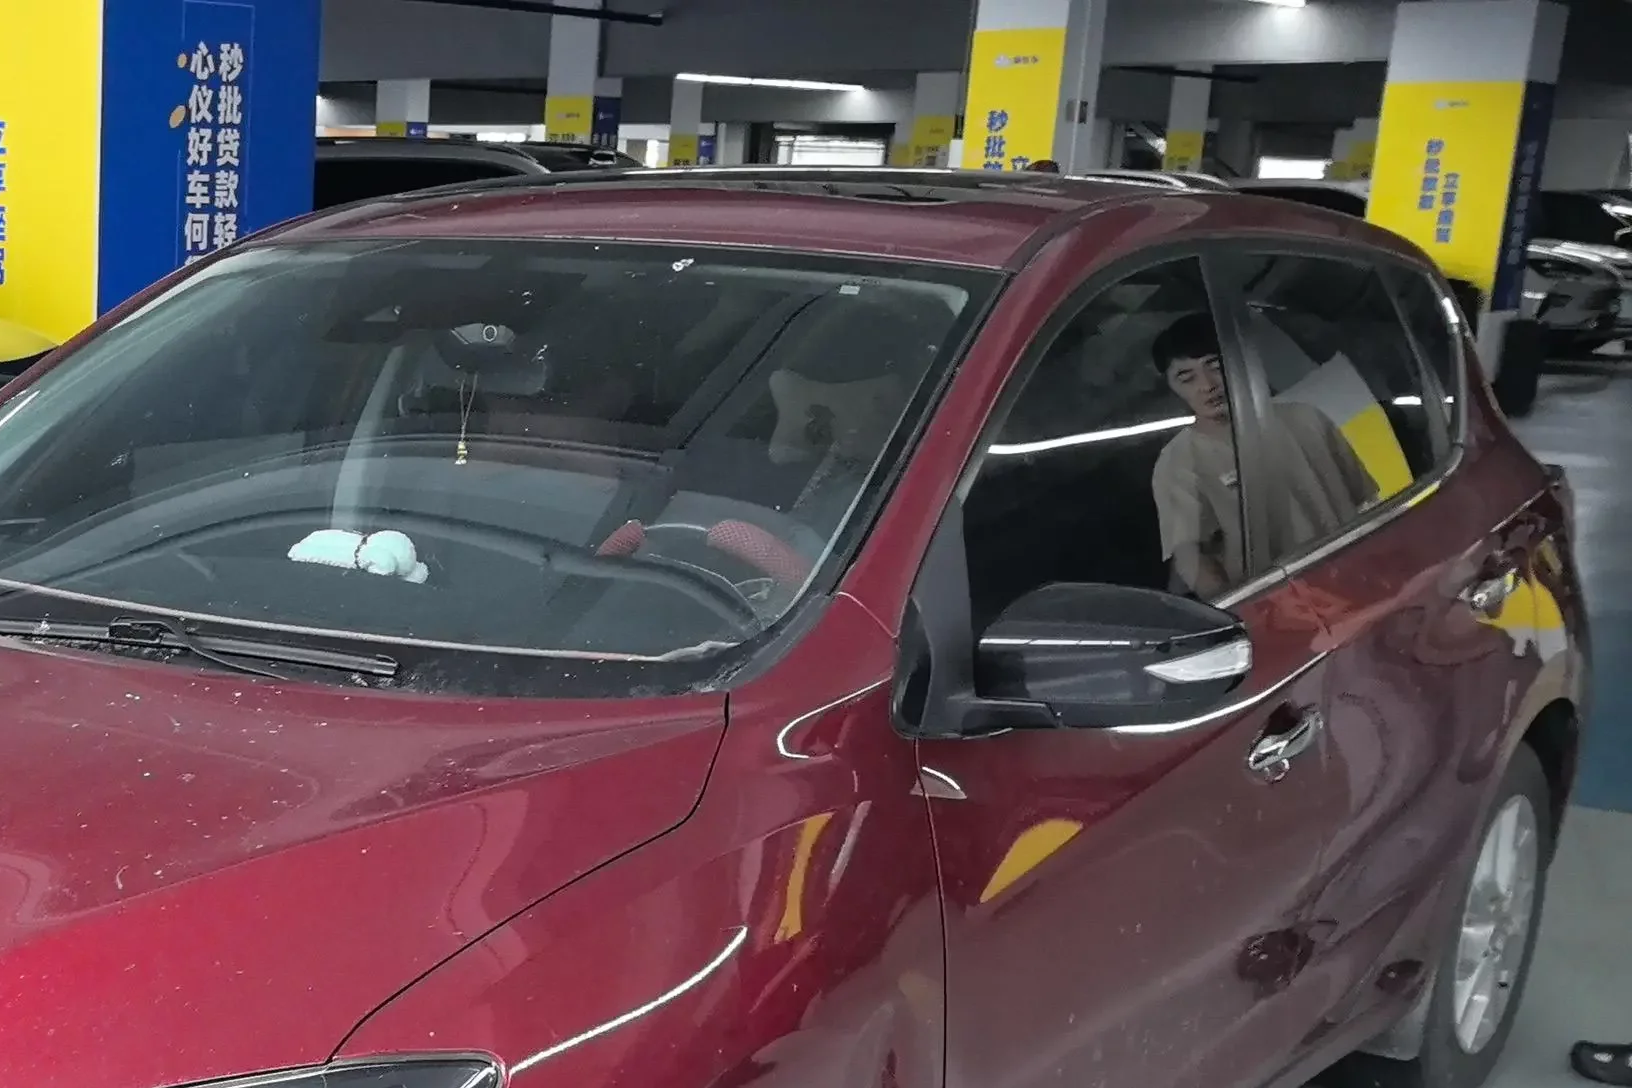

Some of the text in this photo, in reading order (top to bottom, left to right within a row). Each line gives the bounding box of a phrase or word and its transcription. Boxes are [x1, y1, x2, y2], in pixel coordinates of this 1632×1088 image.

[212, 43, 244, 249] 秒批贷款轻
